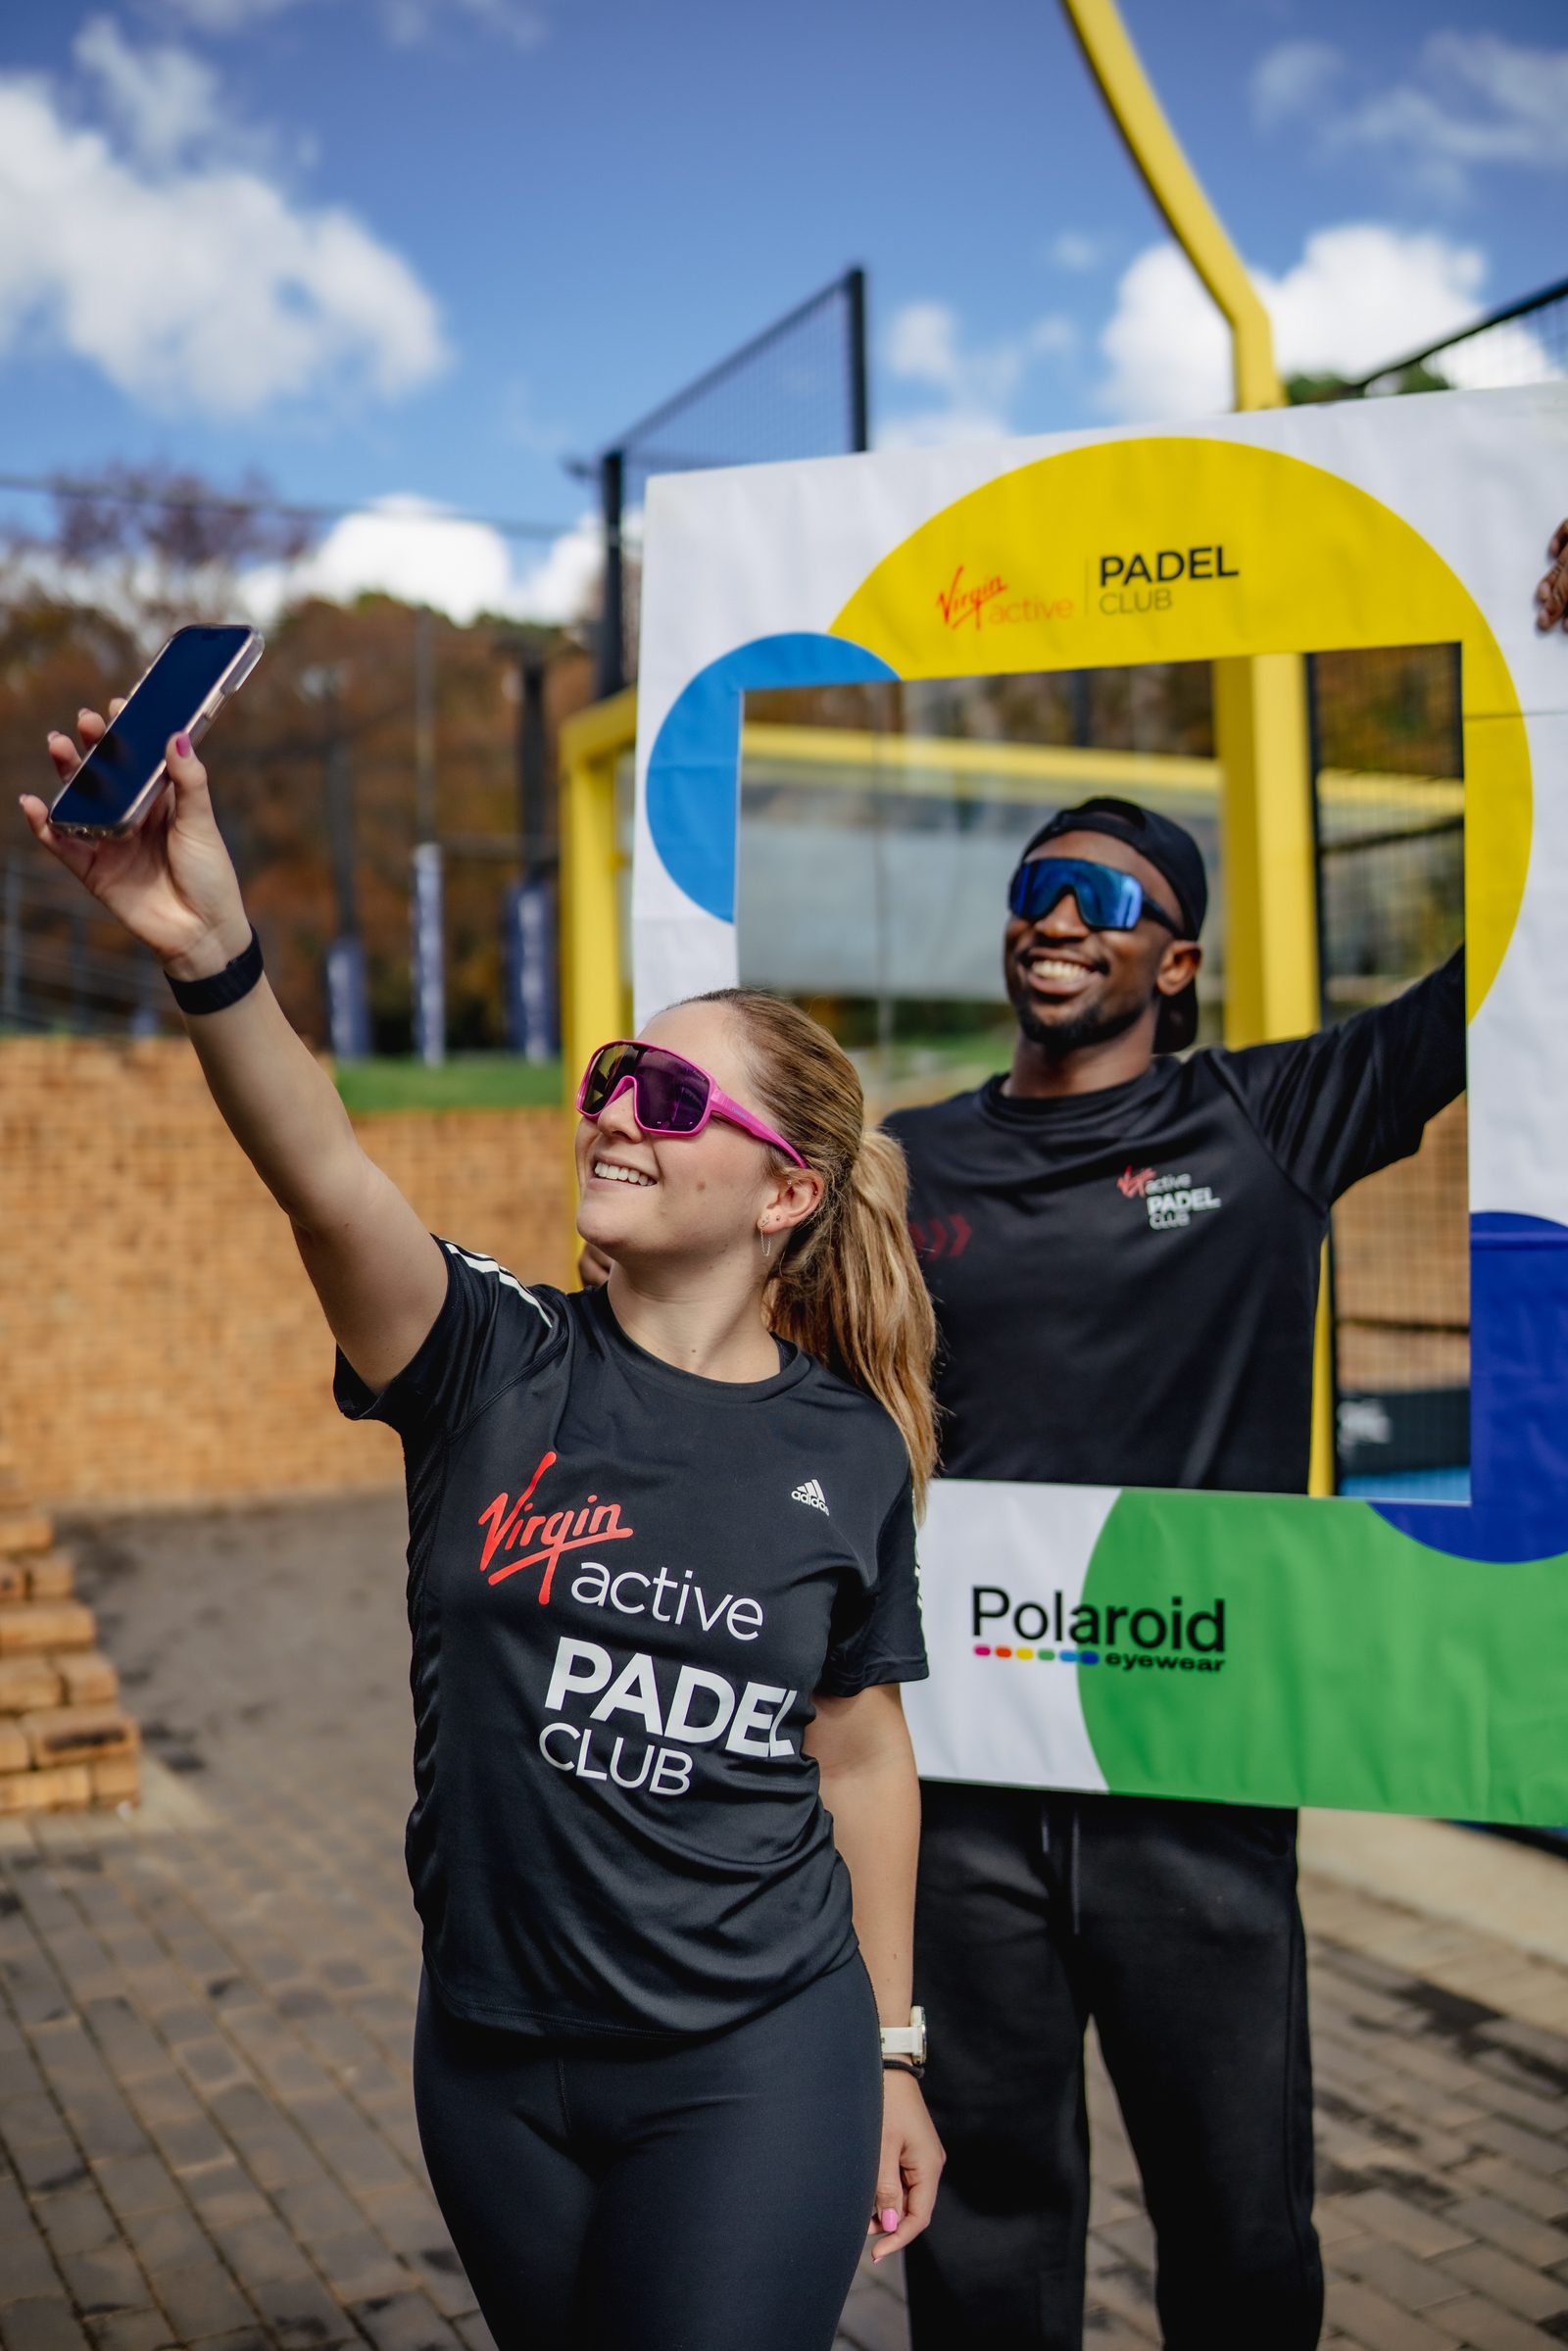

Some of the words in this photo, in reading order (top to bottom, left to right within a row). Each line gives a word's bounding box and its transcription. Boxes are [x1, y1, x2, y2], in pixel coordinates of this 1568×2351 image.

[936, 564, 1008, 630] Virgin
[988, 596, 1074, 626] active
[1099, 545, 1240, 588] PADEL
[1099, 588, 1173, 616] CLUB
[1147, 1187, 1222, 1215] PADEL
[478, 1451, 633, 1605] Virgin
[570, 1561, 764, 1641] active
[971, 1585, 1226, 1653] Polaroid
[1104, 1651, 1226, 1672] eyewear
[544, 1636, 799, 1758] PADEL
[538, 1722, 694, 1796] CLUB
